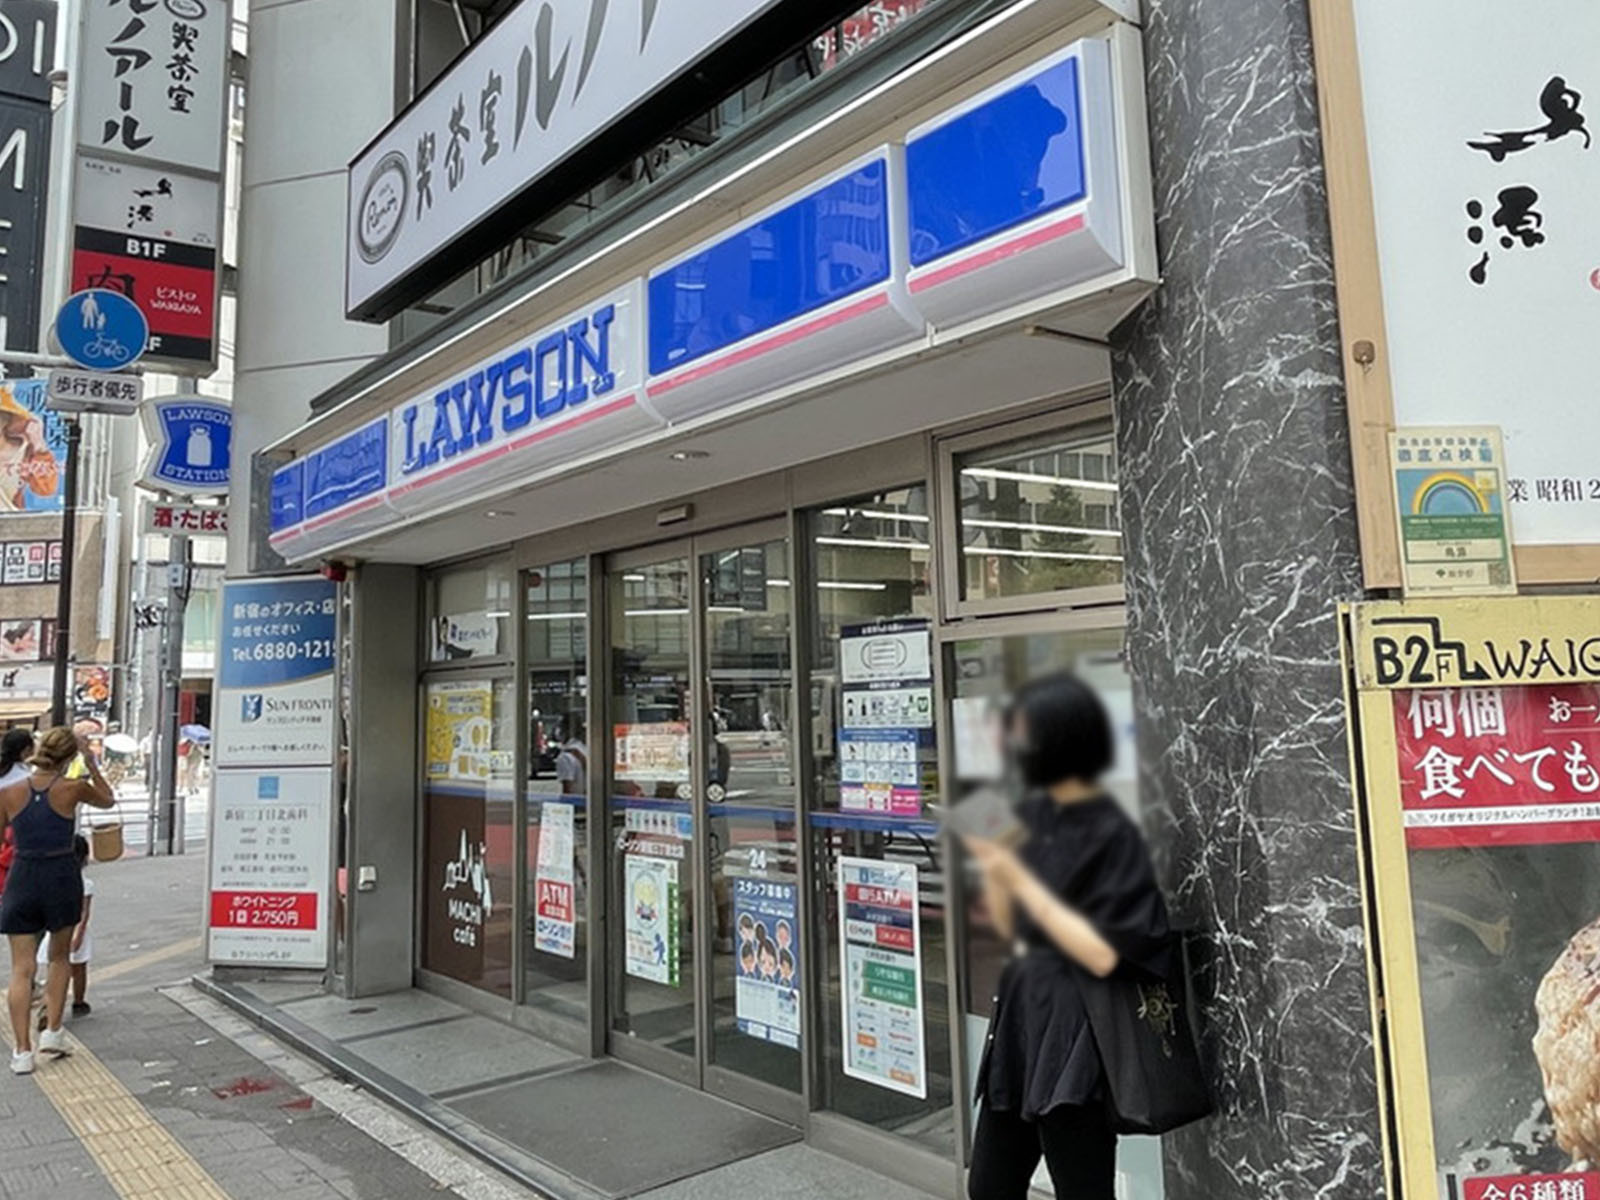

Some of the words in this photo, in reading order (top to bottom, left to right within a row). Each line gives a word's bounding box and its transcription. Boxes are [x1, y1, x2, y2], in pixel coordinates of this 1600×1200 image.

[165, 21, 200, 115] 喫茶室
[415, 68, 503, 222] 喫茶室
[126, 240, 166, 259] B1F
[156, 287, 197, 302] ビストロ
[56, 376, 137, 401] 歩行者優先
[402, 303, 616, 476] LAWSON
[1536, 478, 1582, 502] 昭和
[232, 624, 301, 639] お任せください
[1406, 688, 1506, 740] 何個
[1548, 695, 1600, 724] お一
[1413, 741, 1600, 802] 食べても
[749, 848, 767, 869] 24
[232, 896, 297, 909] ホワイトニング
[229, 909, 248, 924] 1回
